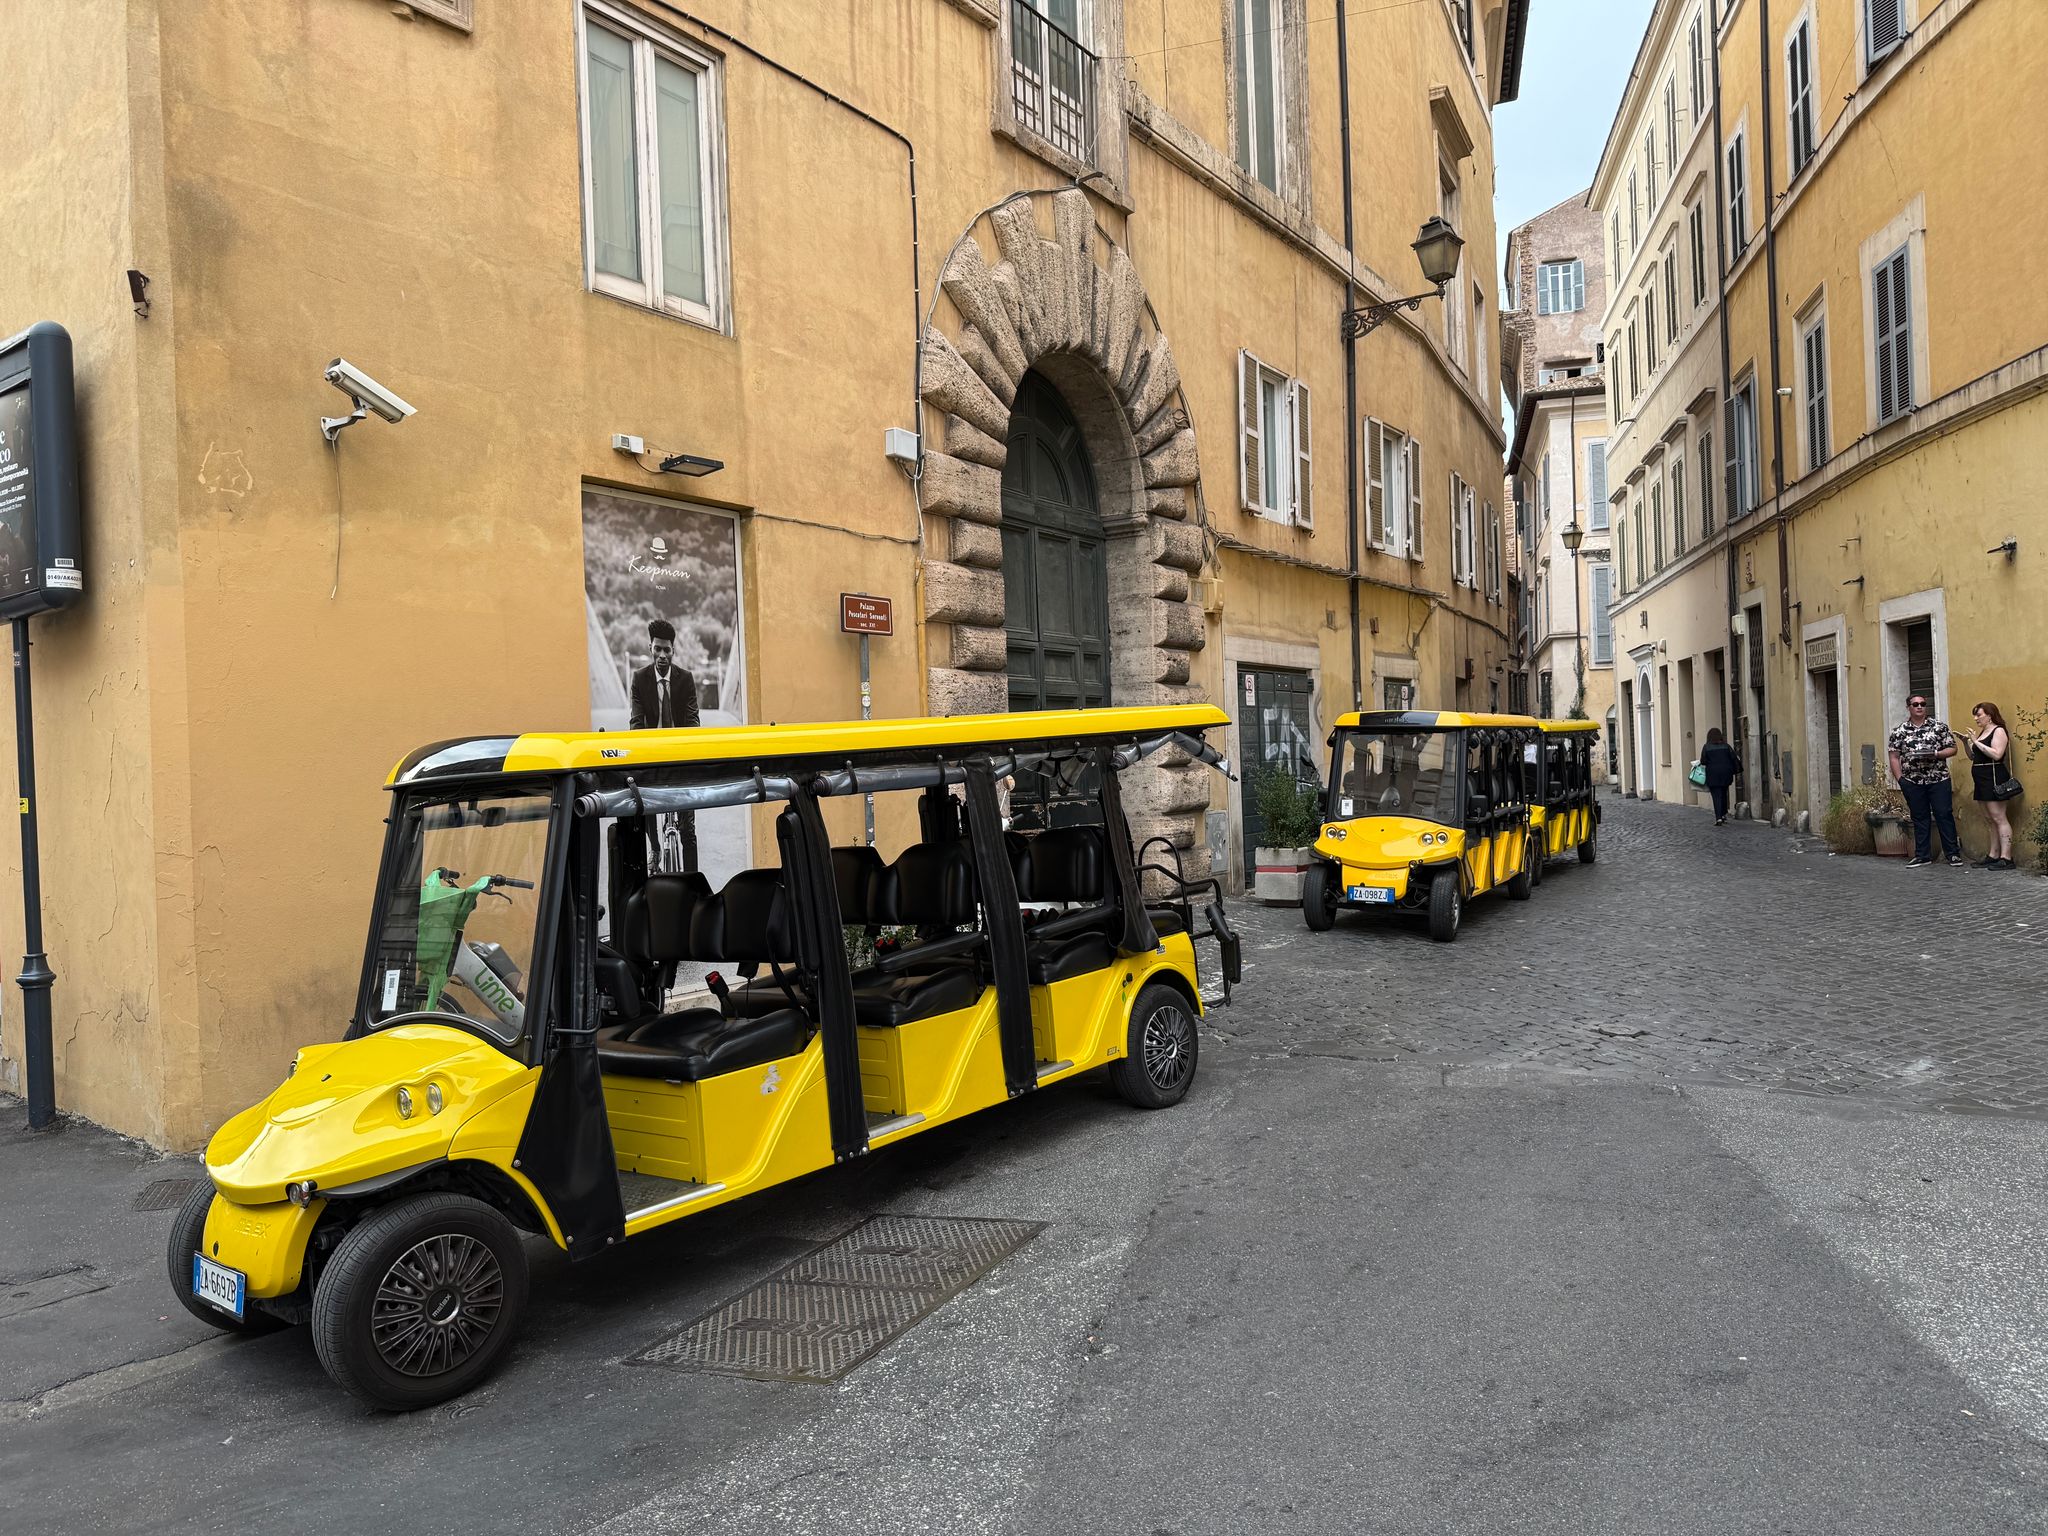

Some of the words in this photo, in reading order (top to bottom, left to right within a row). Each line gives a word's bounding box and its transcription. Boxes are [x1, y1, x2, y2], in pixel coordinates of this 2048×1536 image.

[628, 554, 691, 582] Keepman
[859, 602, 876, 612] Palazzo
[1809, 639, 1835, 656] TRATTORIA
